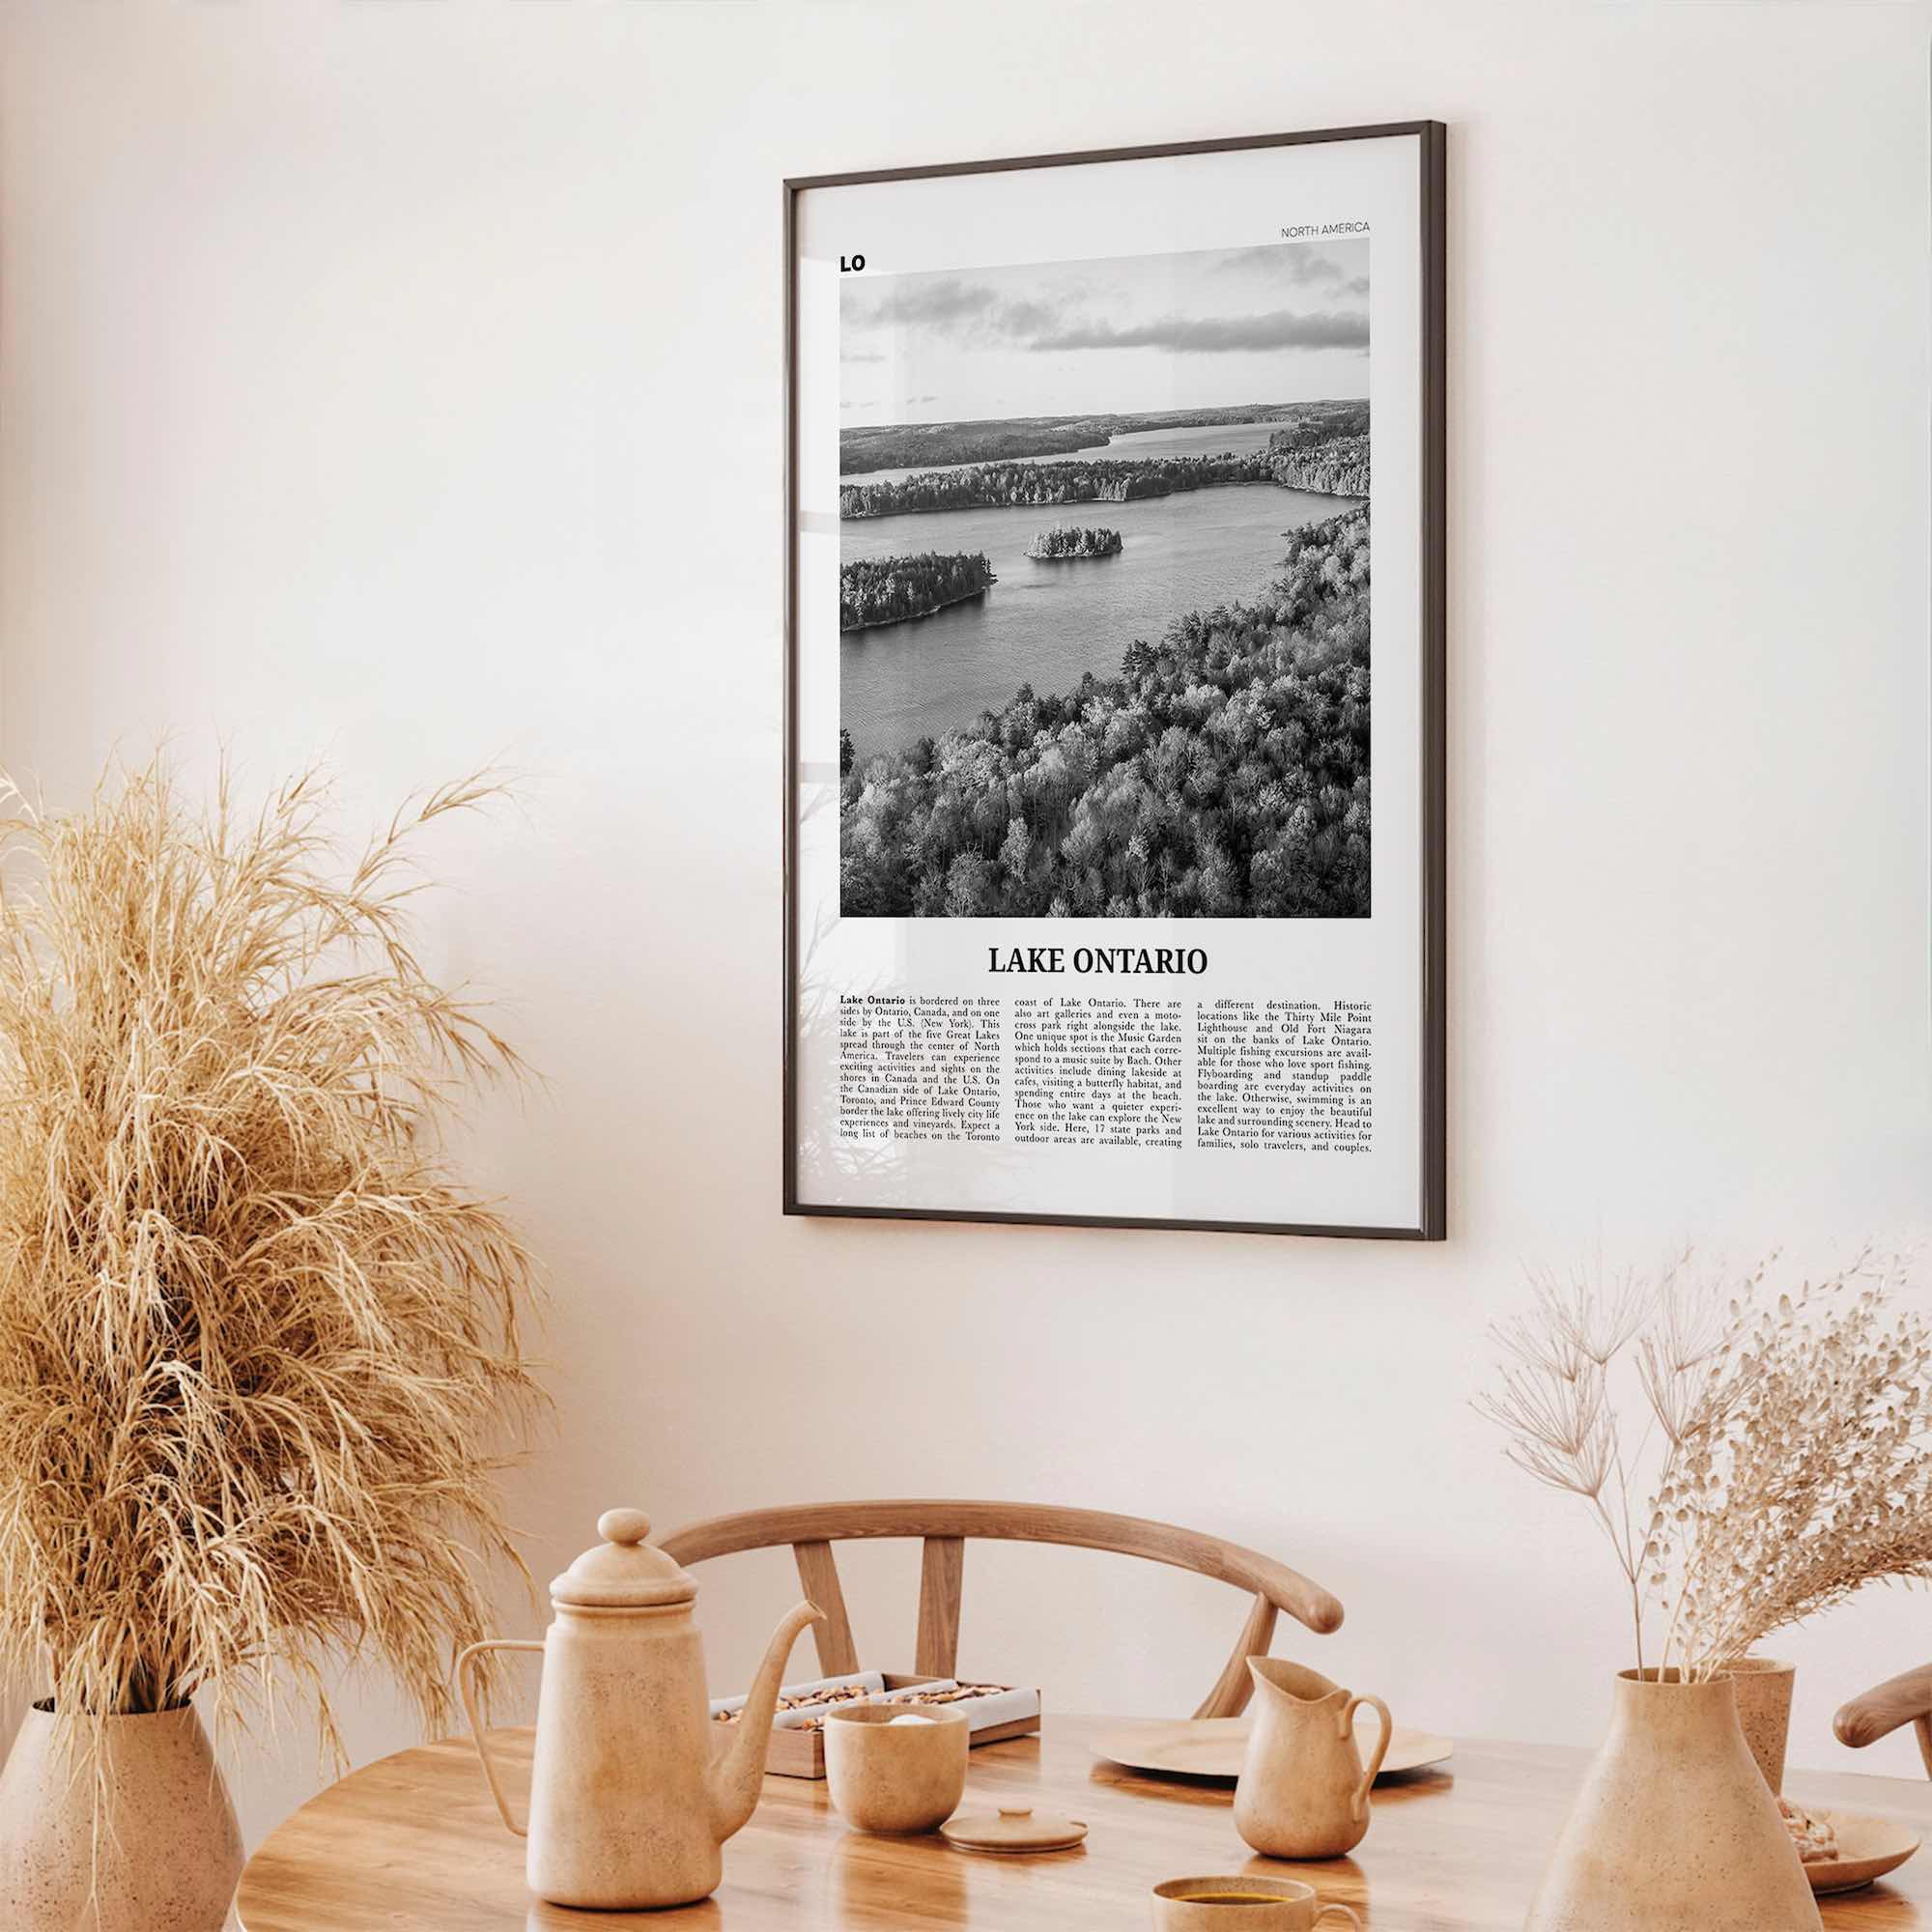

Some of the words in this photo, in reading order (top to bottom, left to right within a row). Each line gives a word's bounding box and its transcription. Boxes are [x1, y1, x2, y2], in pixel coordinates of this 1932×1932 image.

[1282, 226, 1319, 238] NORTH
[1321, 221, 1370, 234] AMERICA
[840, 254, 866, 271] LO
[988, 948, 1065, 973] LAKE
[1073, 948, 1208, 974] ONTARIO
[840, 995, 863, 1004] Lake
[867, 995, 905, 1004] Ontario
[909, 996, 916, 1004] is
[920, 996, 958, 1005] bordered
[977, 996, 1000, 1005] three
[1043, 997, 1052, 1006] of
[1060, 998, 1081, 1007] Lake
[1088, 998, 1126, 1007] Ontario.
[1133, 998, 1160, 1007] There
[1214, 999, 1253, 1009] different
[1266, 1000, 1320, 1010] destination.
[1334, 1001, 1371, 1010] Historic
[840, 1006, 859, 1015] sides
[862, 1006, 872, 1017] by
[874, 1007, 911, 1017] Ontario,
[913, 1007, 949, 1017] Canada,
[951, 1007, 968, 1016] and
[1014, 1008, 1031, 1017] also
[1054, 1009, 1091, 1020] galleries
[1096, 1009, 1113, 1018] and
[1197, 1011, 1238, 1020] locations
[1243, 1011, 1259, 1020] like
[1264, 1012, 1279, 1021] the
[1284, 1012, 1314, 1024] Thirty
[1320, 1013, 1341, 1022] Mile
[1347, 1013, 1371, 1022] Point
[839, 1017, 856, 1026] side
[862, 1017, 872, 1029] by
[878, 1018, 891, 1026] the
[897, 1018, 914, 1027] U.S.
[920, 1018, 943, 1028] (New
[948, 1019, 973, 1029] York).
[979, 1019, 1000, 1028] This
[1041, 1020, 1061, 1031] park
[1066, 1021, 1087, 1032] right
[1093, 1021, 1135, 1032] alongside
[1141, 1022, 1154, 1031] the
[1160, 1022, 1181, 1031] lake.
[1198, 1023, 1247, 1034] Lighthouse
[1255, 1023, 1272, 1032] and
[1281, 1024, 1298, 1033] Old
[1307, 1024, 1325, 1033] Fort
[1334, 1025, 1371, 1036] Niagara
[840, 1028, 856, 1037] lake
[861, 1029, 868, 1037] is
[872, 1030, 889, 1040] part
[893, 1029, 903, 1038] of
[908, 1029, 921, 1038] the
[926, 1029, 941, 1038] five
[946, 1030, 970, 1039] Great
[975, 1030, 1000, 1039] Lakes
[1014, 1031, 1033, 1040] One
[1036, 1032, 1066, 1043] unique
[1069, 1034, 1087, 1043] spot
[1091, 1032, 1097, 1041] is
[1100, 1032, 1114, 1041] the
[1118, 1033, 1144, 1042] Music
[1148, 1033, 1181, 1042] Garden
[840, 1040, 867, 1050] spread
[872, 1040, 905, 1051] through
[910, 1040, 923, 1049] the
[959, 1041, 969, 1050] of
[974, 1042, 999, 1051] North
[1197, 1046, 1236, 1057] Multiple
[1240, 1046, 1270, 1058] fishing
[1274, 1048, 1323, 1057] excursions
[1345, 1048, 1371, 1057] avail-
[840, 1050, 878, 1060] America.
[886, 1051, 924, 1060] Travelers
[953, 1053, 1000, 1064] experience
[1014, 1065, 1053, 1074] activities
[1059, 1066, 1091, 1075] include
[1097, 1067, 1126, 1078] dining
[1131, 1067, 1166, 1077] lakeside
[1198, 1068, 1252, 1081] Flyboarding
[1263, 1070, 1281, 1079] and
[1292, 1071, 1328, 1082] standup
[1340, 1072, 1371, 1083] paddle
[1014, 1076, 1038, 1087] cafes,
[1042, 1077, 1074, 1089] visiting
[1085, 1078, 1123, 1090] butterfly
[1127, 1079, 1161, 1090] habitat,
[1164, 1080, 1181, 1089] and
[1197, 1080, 1238, 1092] boarding
[1264, 1082, 1305, 1094] everyday
[1312, 1083, 1353, 1092] activities
[1014, 1088, 1053, 1099] spending
[1059, 1089, 1085, 1098] entire
[1091, 1089, 1111, 1101] days
[1132, 1090, 1145, 1099] the
[1152, 1091, 1181, 1100] beach.
[1197, 1092, 1211, 1101] the
[1216, 1092, 1237, 1102] lake.
[1242, 1093, 1292, 1104] Otherwise,
[1296, 1095, 1343, 1106] swimming
[1348, 1096, 1355, 1104] is
[839, 1095, 876, 1105] Toronto,
[880, 1096, 896, 1105] and
[900, 1096, 927, 1105] Prince
[931, 1097, 964, 1106] Edward
[968, 1098, 1000, 1110] County
[1197, 1104, 1237, 1113] excellent
[1242, 1108, 1260, 1116] way
[1279, 1106, 1305, 1117] enjoy
[1310, 1106, 1324, 1115] the
[1330, 1107, 1371, 1116] beautiful
[839, 1118, 888, 1128] experiences
[892, 1118, 908, 1127] and
[912, 1119, 956, 1130] vineyards.
[961, 1120, 990, 1132] Expect
[1014, 1133, 1049, 1142] outdoor
[1099, 1136, 1141, 1147] available,
[1145, 1138, 1182, 1149] creating
[1197, 1138, 1235, 1149] families,
[1240, 1140, 1259, 1149] solo
[1263, 1141, 1306, 1151] travelers,
[1311, 1142, 1328, 1151] and
[1333, 1142, 1371, 1154] couples.
